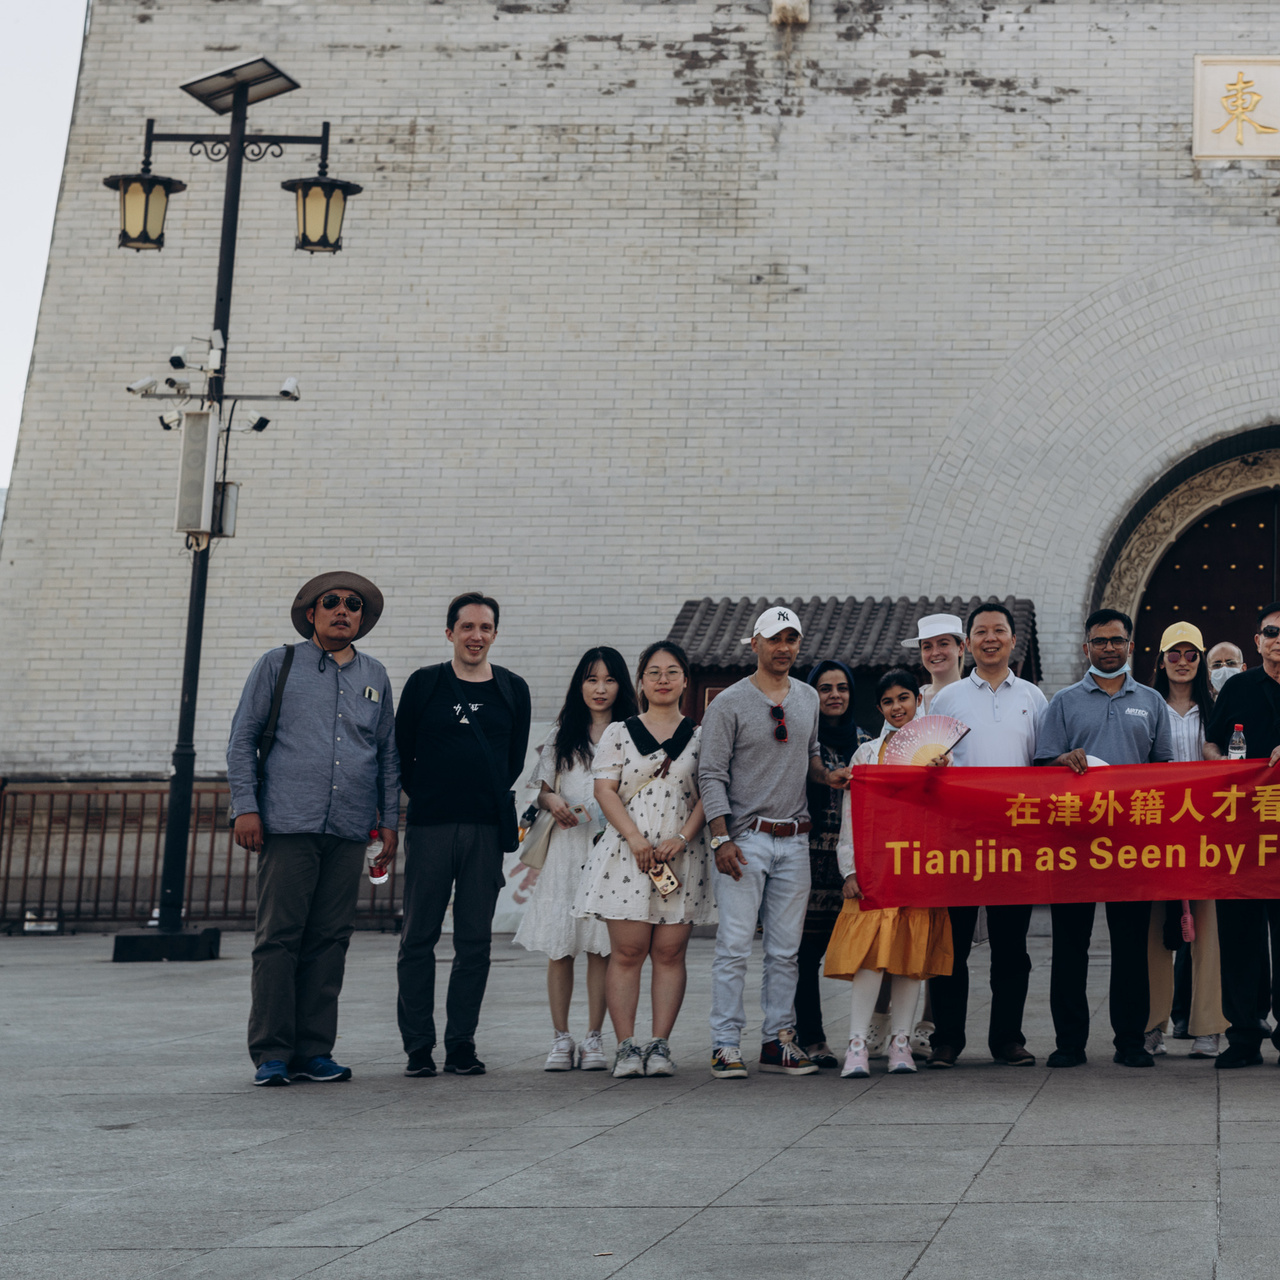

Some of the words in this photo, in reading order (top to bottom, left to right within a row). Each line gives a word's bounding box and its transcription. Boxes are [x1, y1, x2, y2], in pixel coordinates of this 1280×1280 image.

[885, 839, 1022, 882] Tianjin
[1035, 846, 1077, 872] as
[1089, 836, 1186, 870] Seen
[1199, 834, 1246, 875] by
